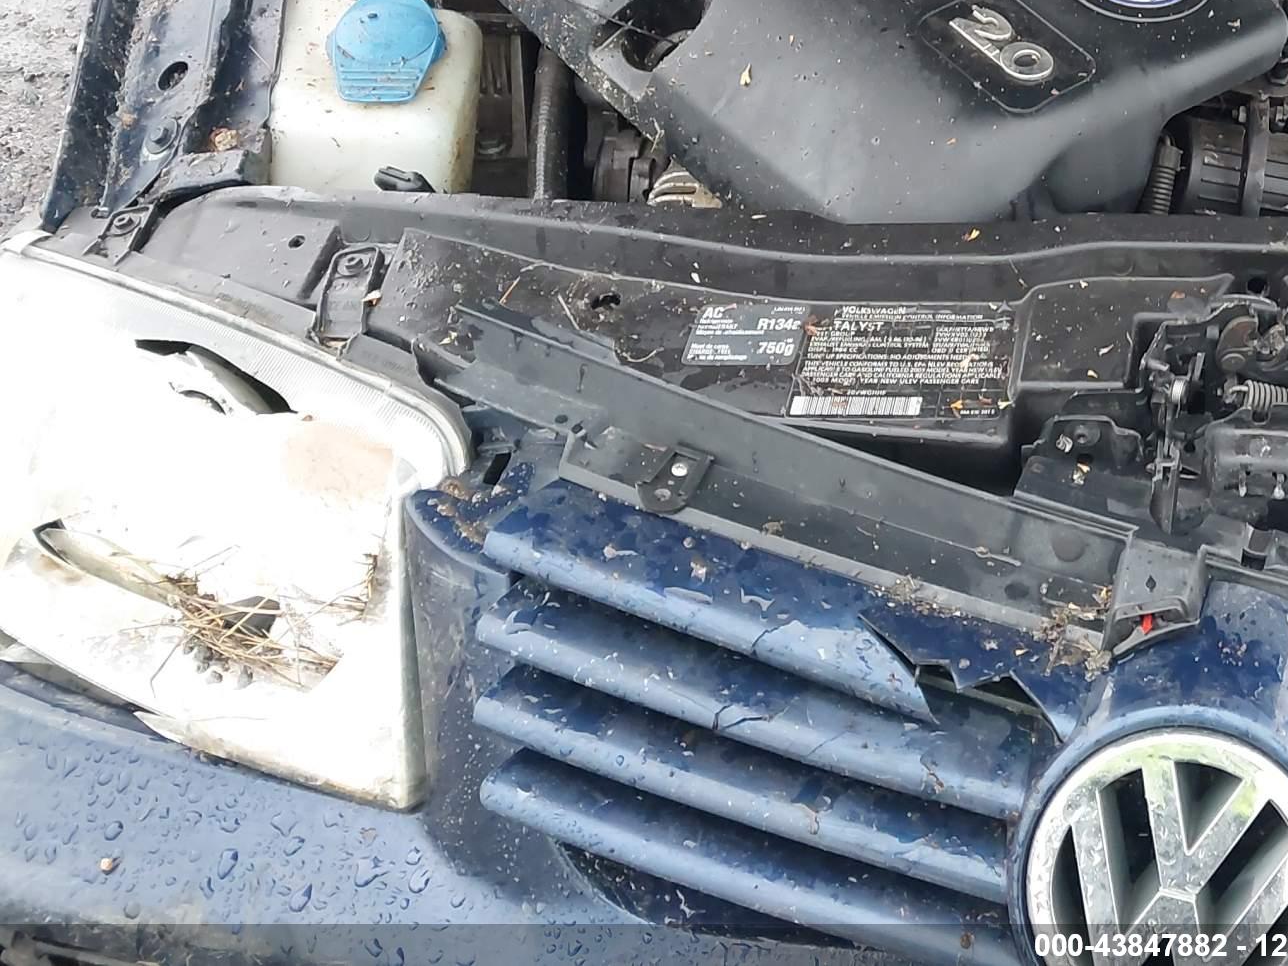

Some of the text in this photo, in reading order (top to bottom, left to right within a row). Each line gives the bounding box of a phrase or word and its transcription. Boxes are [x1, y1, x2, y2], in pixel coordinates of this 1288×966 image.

[702, 307, 724, 319] AC
[842, 306, 906, 314] VOLKSWAGEN
[757, 318, 801, 331] R134a
[757, 342, 795, 356] 750g
